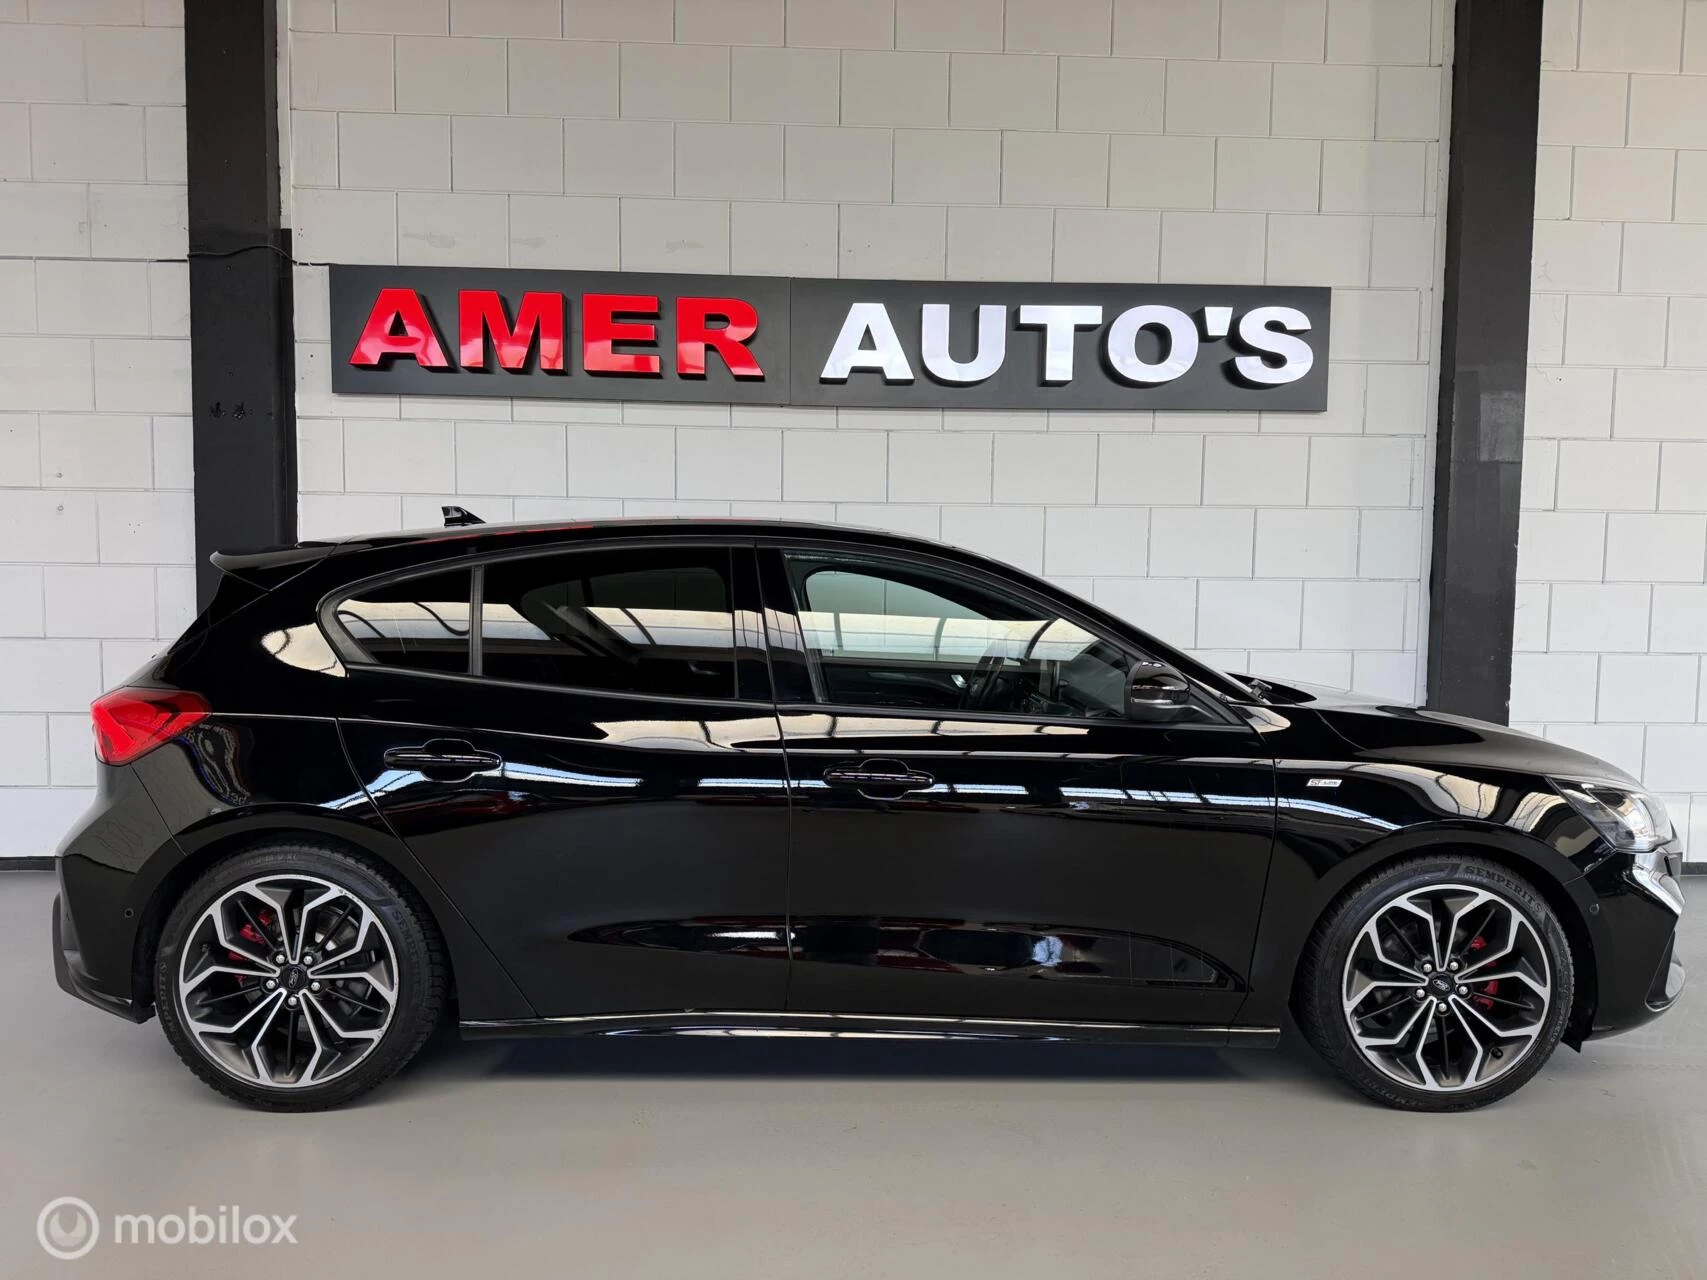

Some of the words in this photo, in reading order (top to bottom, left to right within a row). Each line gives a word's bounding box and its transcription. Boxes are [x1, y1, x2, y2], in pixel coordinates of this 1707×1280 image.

[348, 287, 766, 381] AMER
[819, 302, 1314, 386] AUTO'S
[1464, 865, 1536, 906] SEMPERIT
